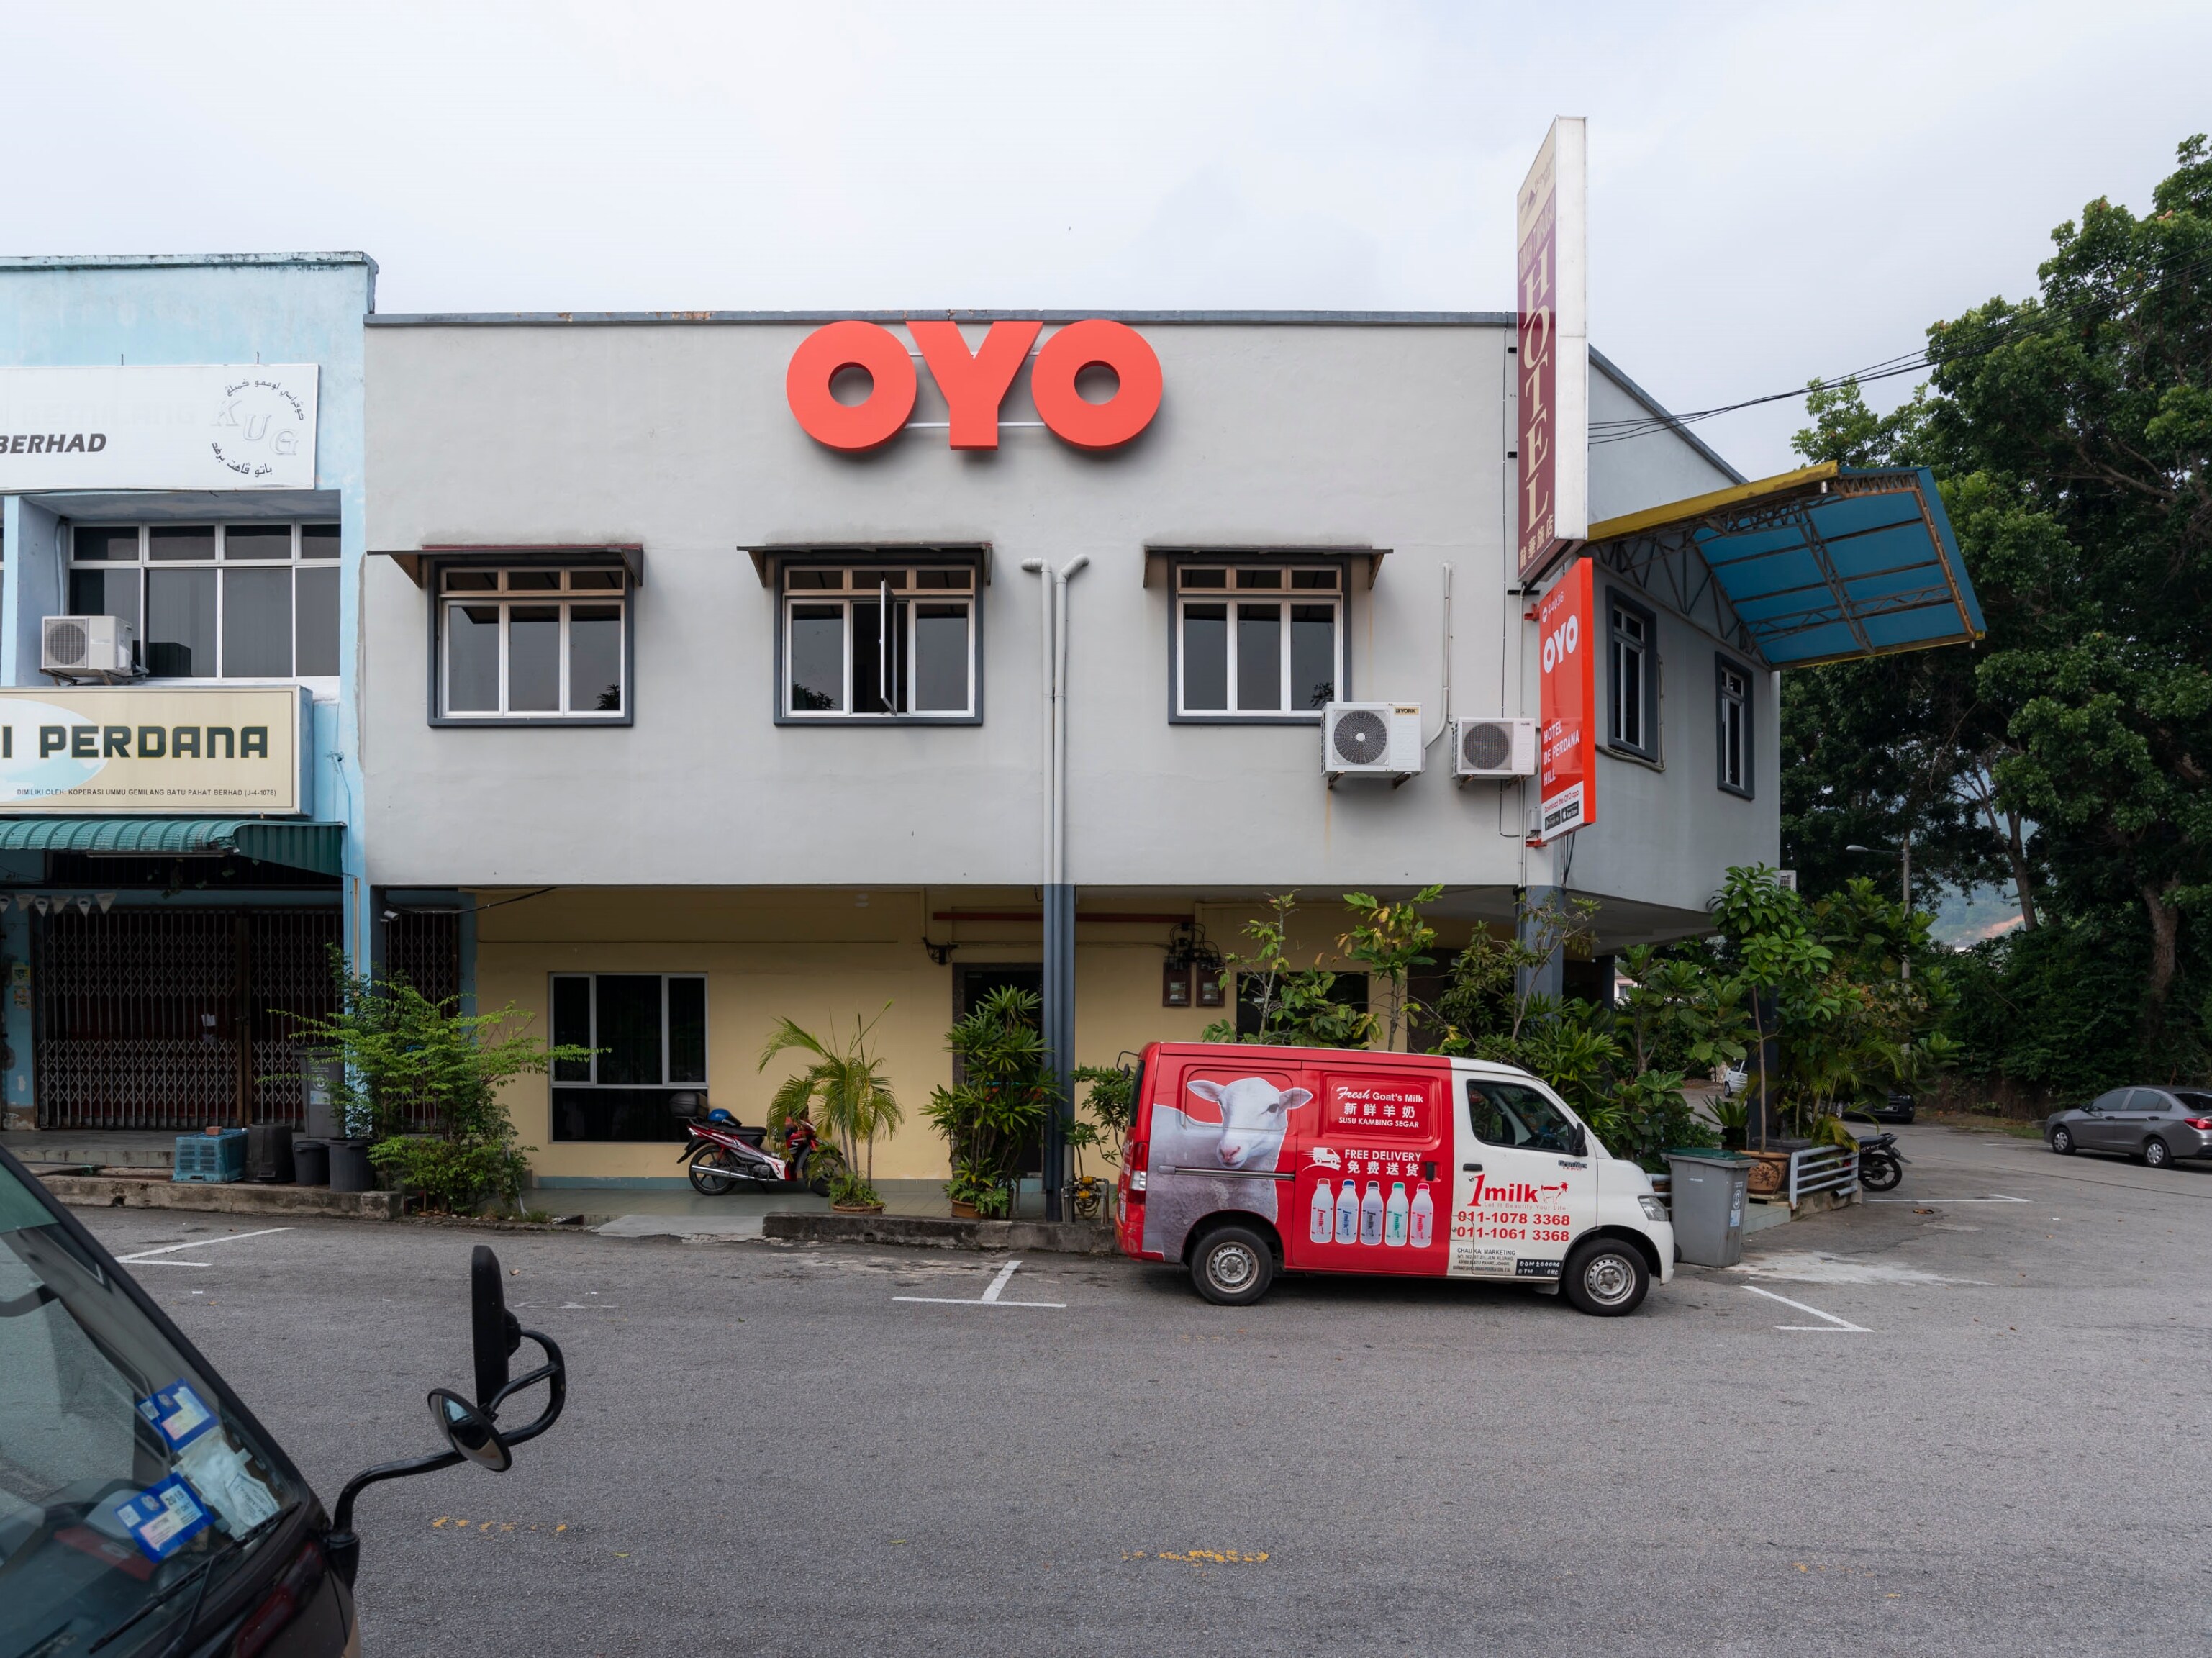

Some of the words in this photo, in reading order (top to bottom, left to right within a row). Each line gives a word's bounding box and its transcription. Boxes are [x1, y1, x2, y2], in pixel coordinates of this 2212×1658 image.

[786, 319, 1163, 451] OYO
[1523, 237, 1551, 533] HOTEL
[1543, 614, 1578, 674] OYO
[1544, 720, 1562, 744] HOTEL
[40, 726, 268, 758] PERDANA
[1544, 749, 1551, 766] DE
[1552, 729, 1579, 760] PERDANA
[1544, 768, 1556, 787] HILL
[1336, 1086, 1371, 1100] Fresh
[1372, 1092, 1402, 1102] Goat's
[1405, 1094, 1423, 1102] Milk
[1343, 1102, 1415, 1118] 新鲜羊奶
[1358, 1118, 1393, 1126] KAMBING
[1344, 1149, 1369, 1159] FREE
[1372, 1151, 1422, 1162] DELIVERY
[1347, 1160, 1420, 1177] 免费送货
[1467, 1174, 1538, 1207] 1milk
[1458, 1210, 1528, 1224] 011-1078
[1533, 1213, 1570, 1226] 3368
[1456, 1226, 1526, 1240] 011-1061
[1532, 1229, 1569, 1241] 3368
